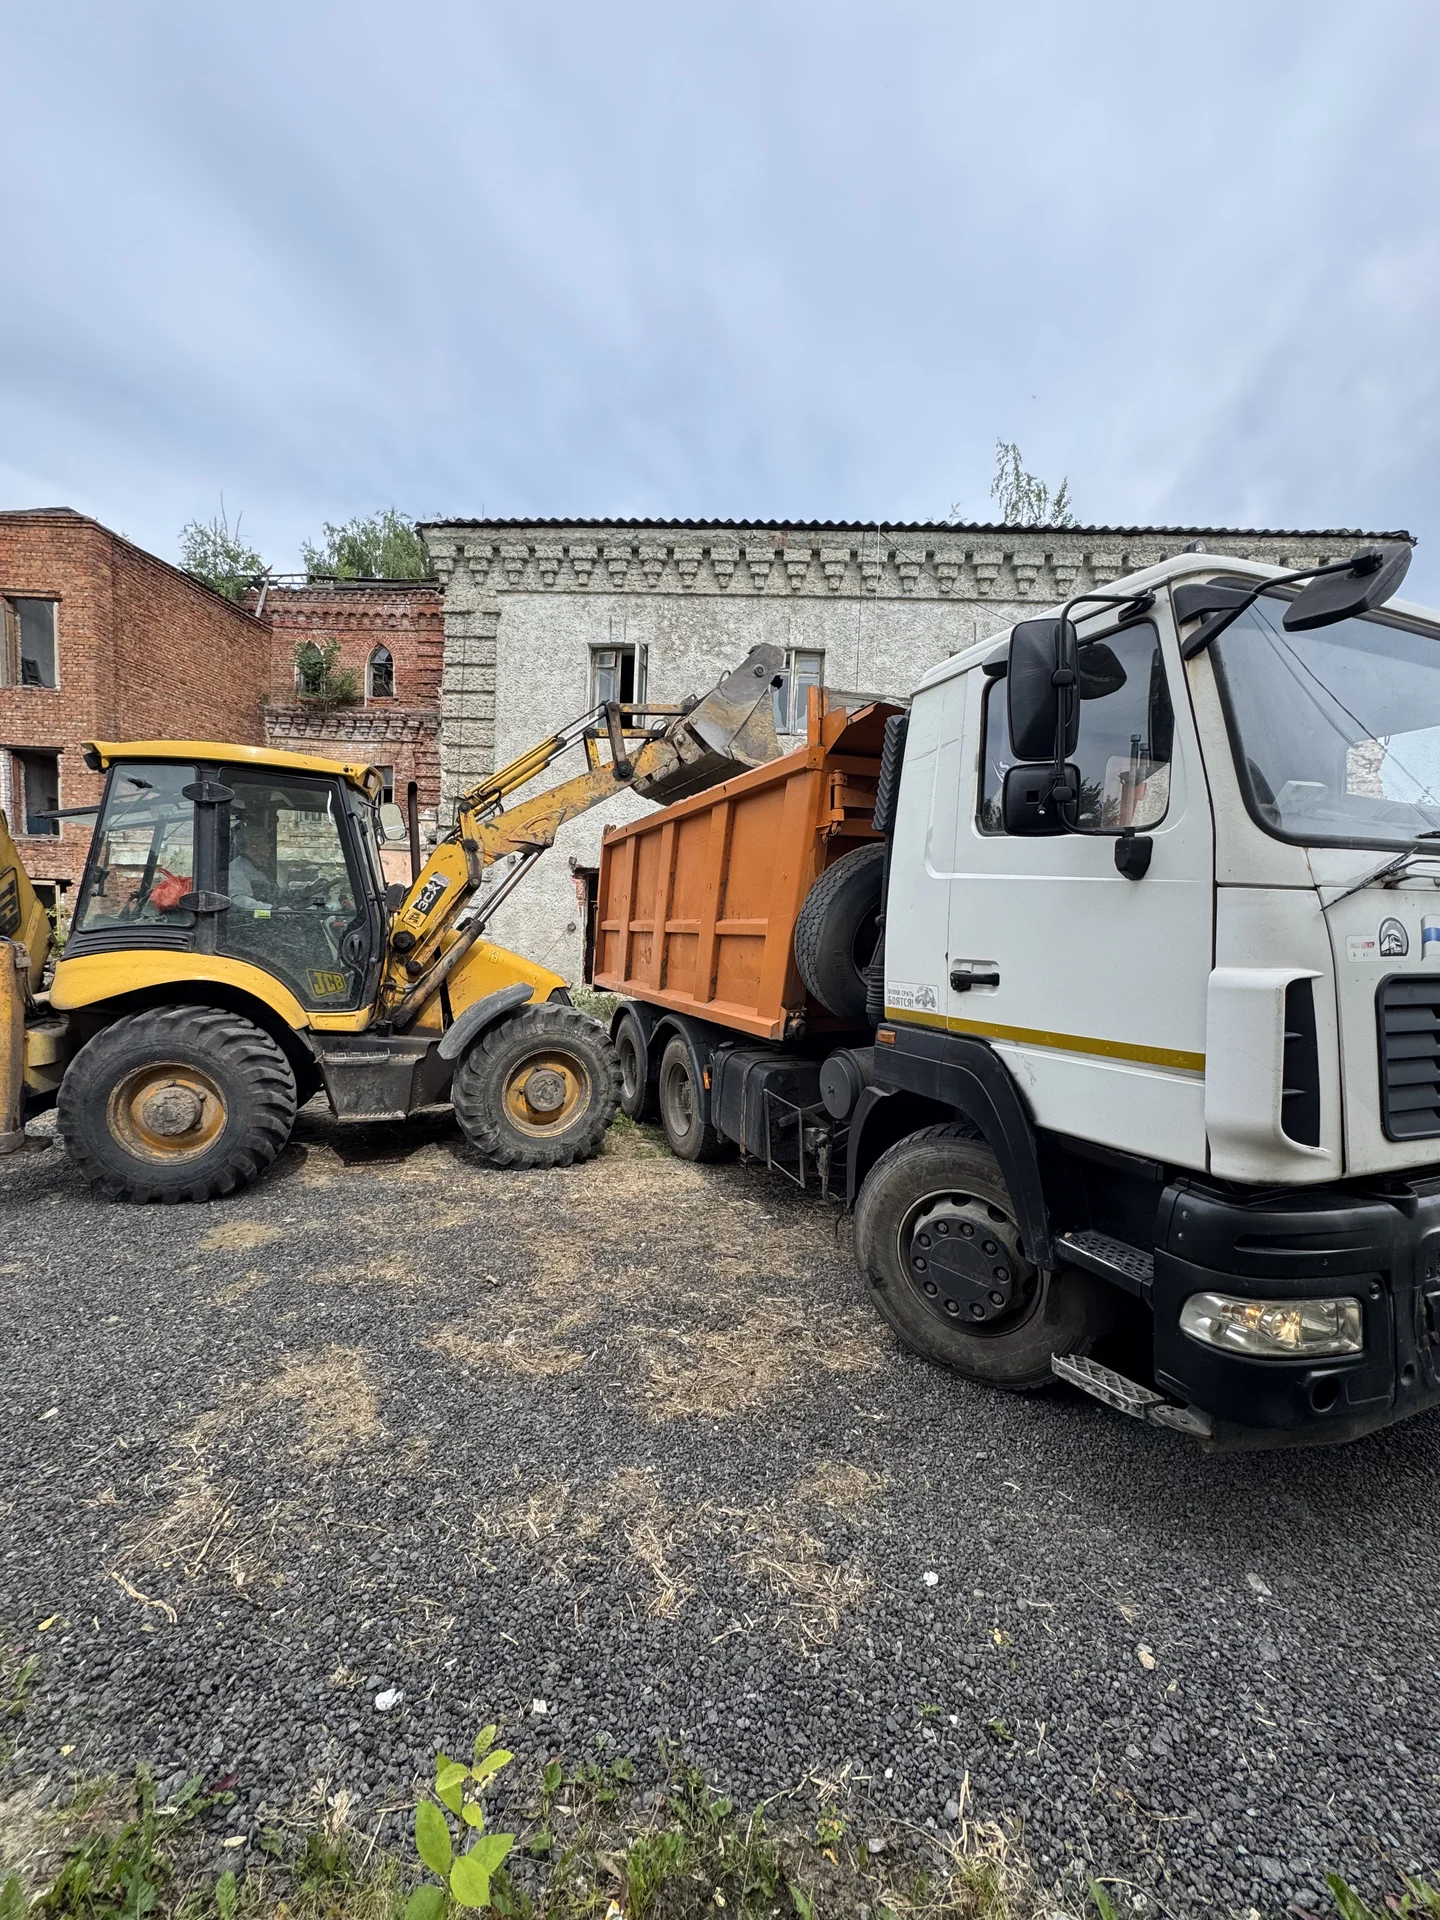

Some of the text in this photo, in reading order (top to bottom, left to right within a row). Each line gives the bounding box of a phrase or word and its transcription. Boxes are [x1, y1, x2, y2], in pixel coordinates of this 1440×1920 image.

[417, 882, 441, 911] 3CX
[313, 971, 344, 995] JCB
[888, 996, 913, 1008] БОЯТСЯ!
